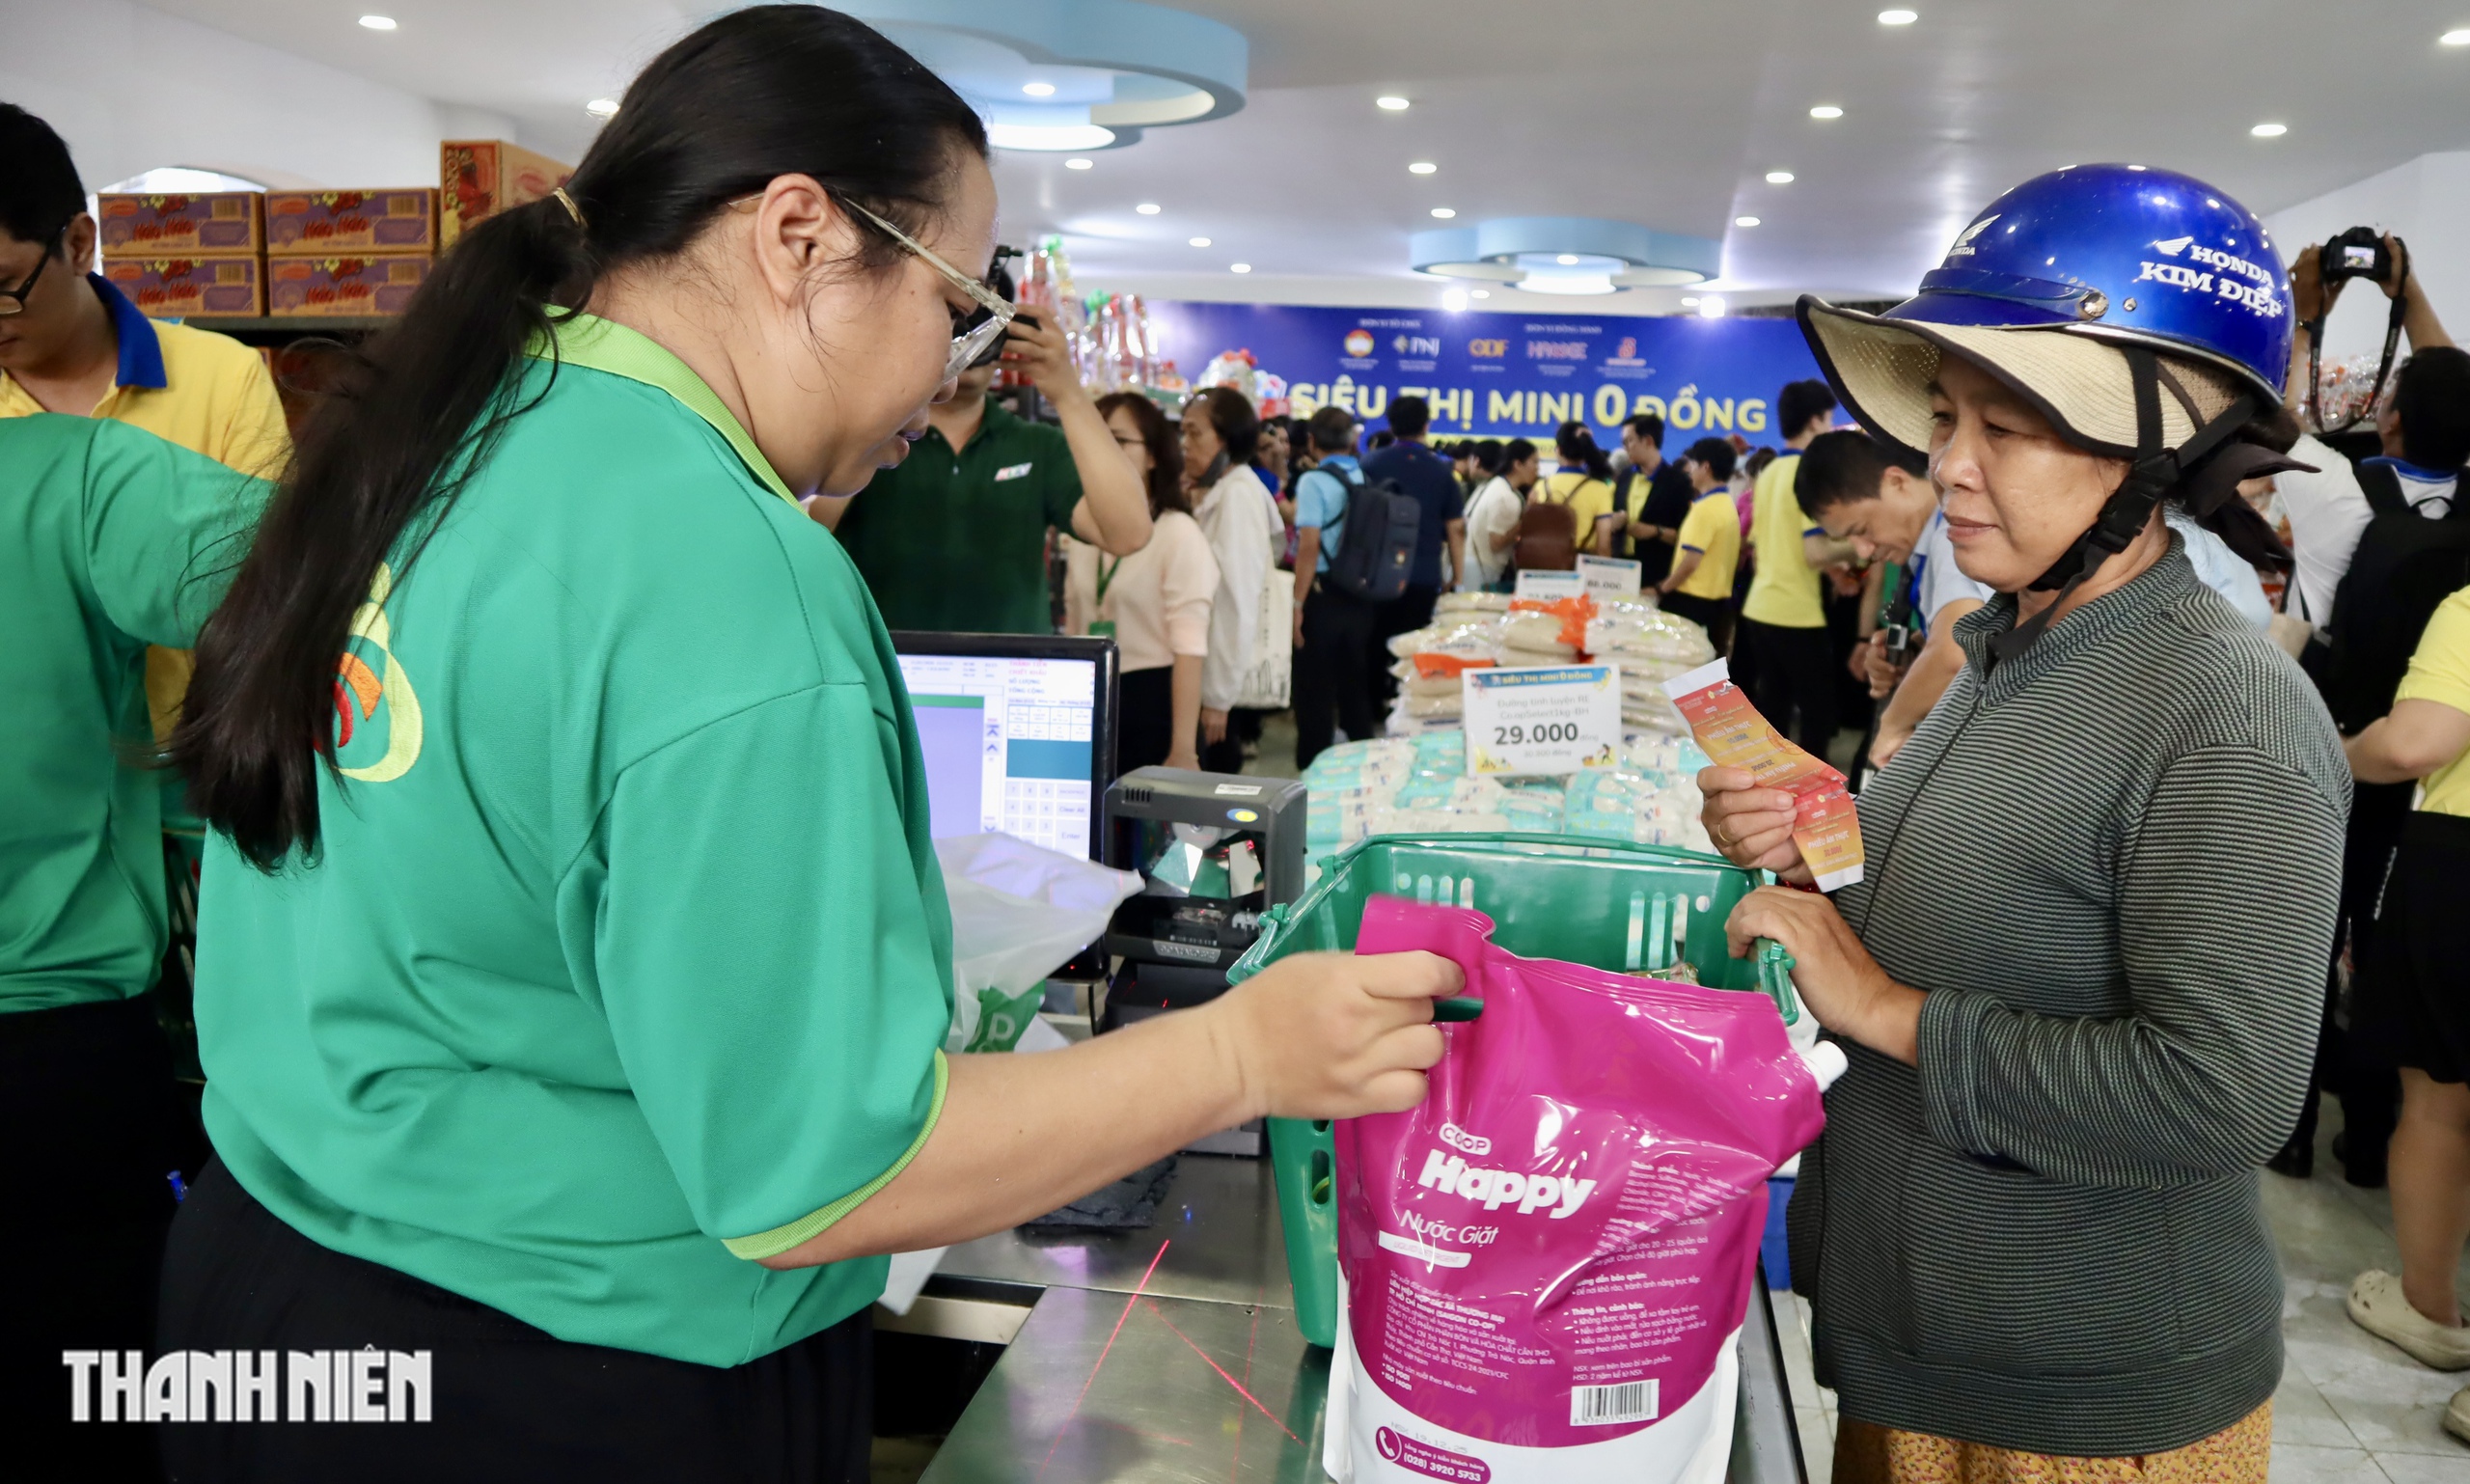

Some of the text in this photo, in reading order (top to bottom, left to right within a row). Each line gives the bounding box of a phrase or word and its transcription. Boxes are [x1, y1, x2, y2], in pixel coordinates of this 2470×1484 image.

[2190, 244, 2275, 288] HONDA
[2139, 261, 2284, 318] KIM ĐIỆP
[1488, 389, 1584, 425] MINI
[1594, 383, 1627, 427] 0
[1633, 383, 1767, 432] ĐỒNG
[1495, 722, 1579, 746] 29.000
[1417, 1148, 1598, 1220] Happy
[1400, 1209, 1499, 1249] Nước Giặt
[1403, 1452, 1482, 1483] (028) 3920 5733
